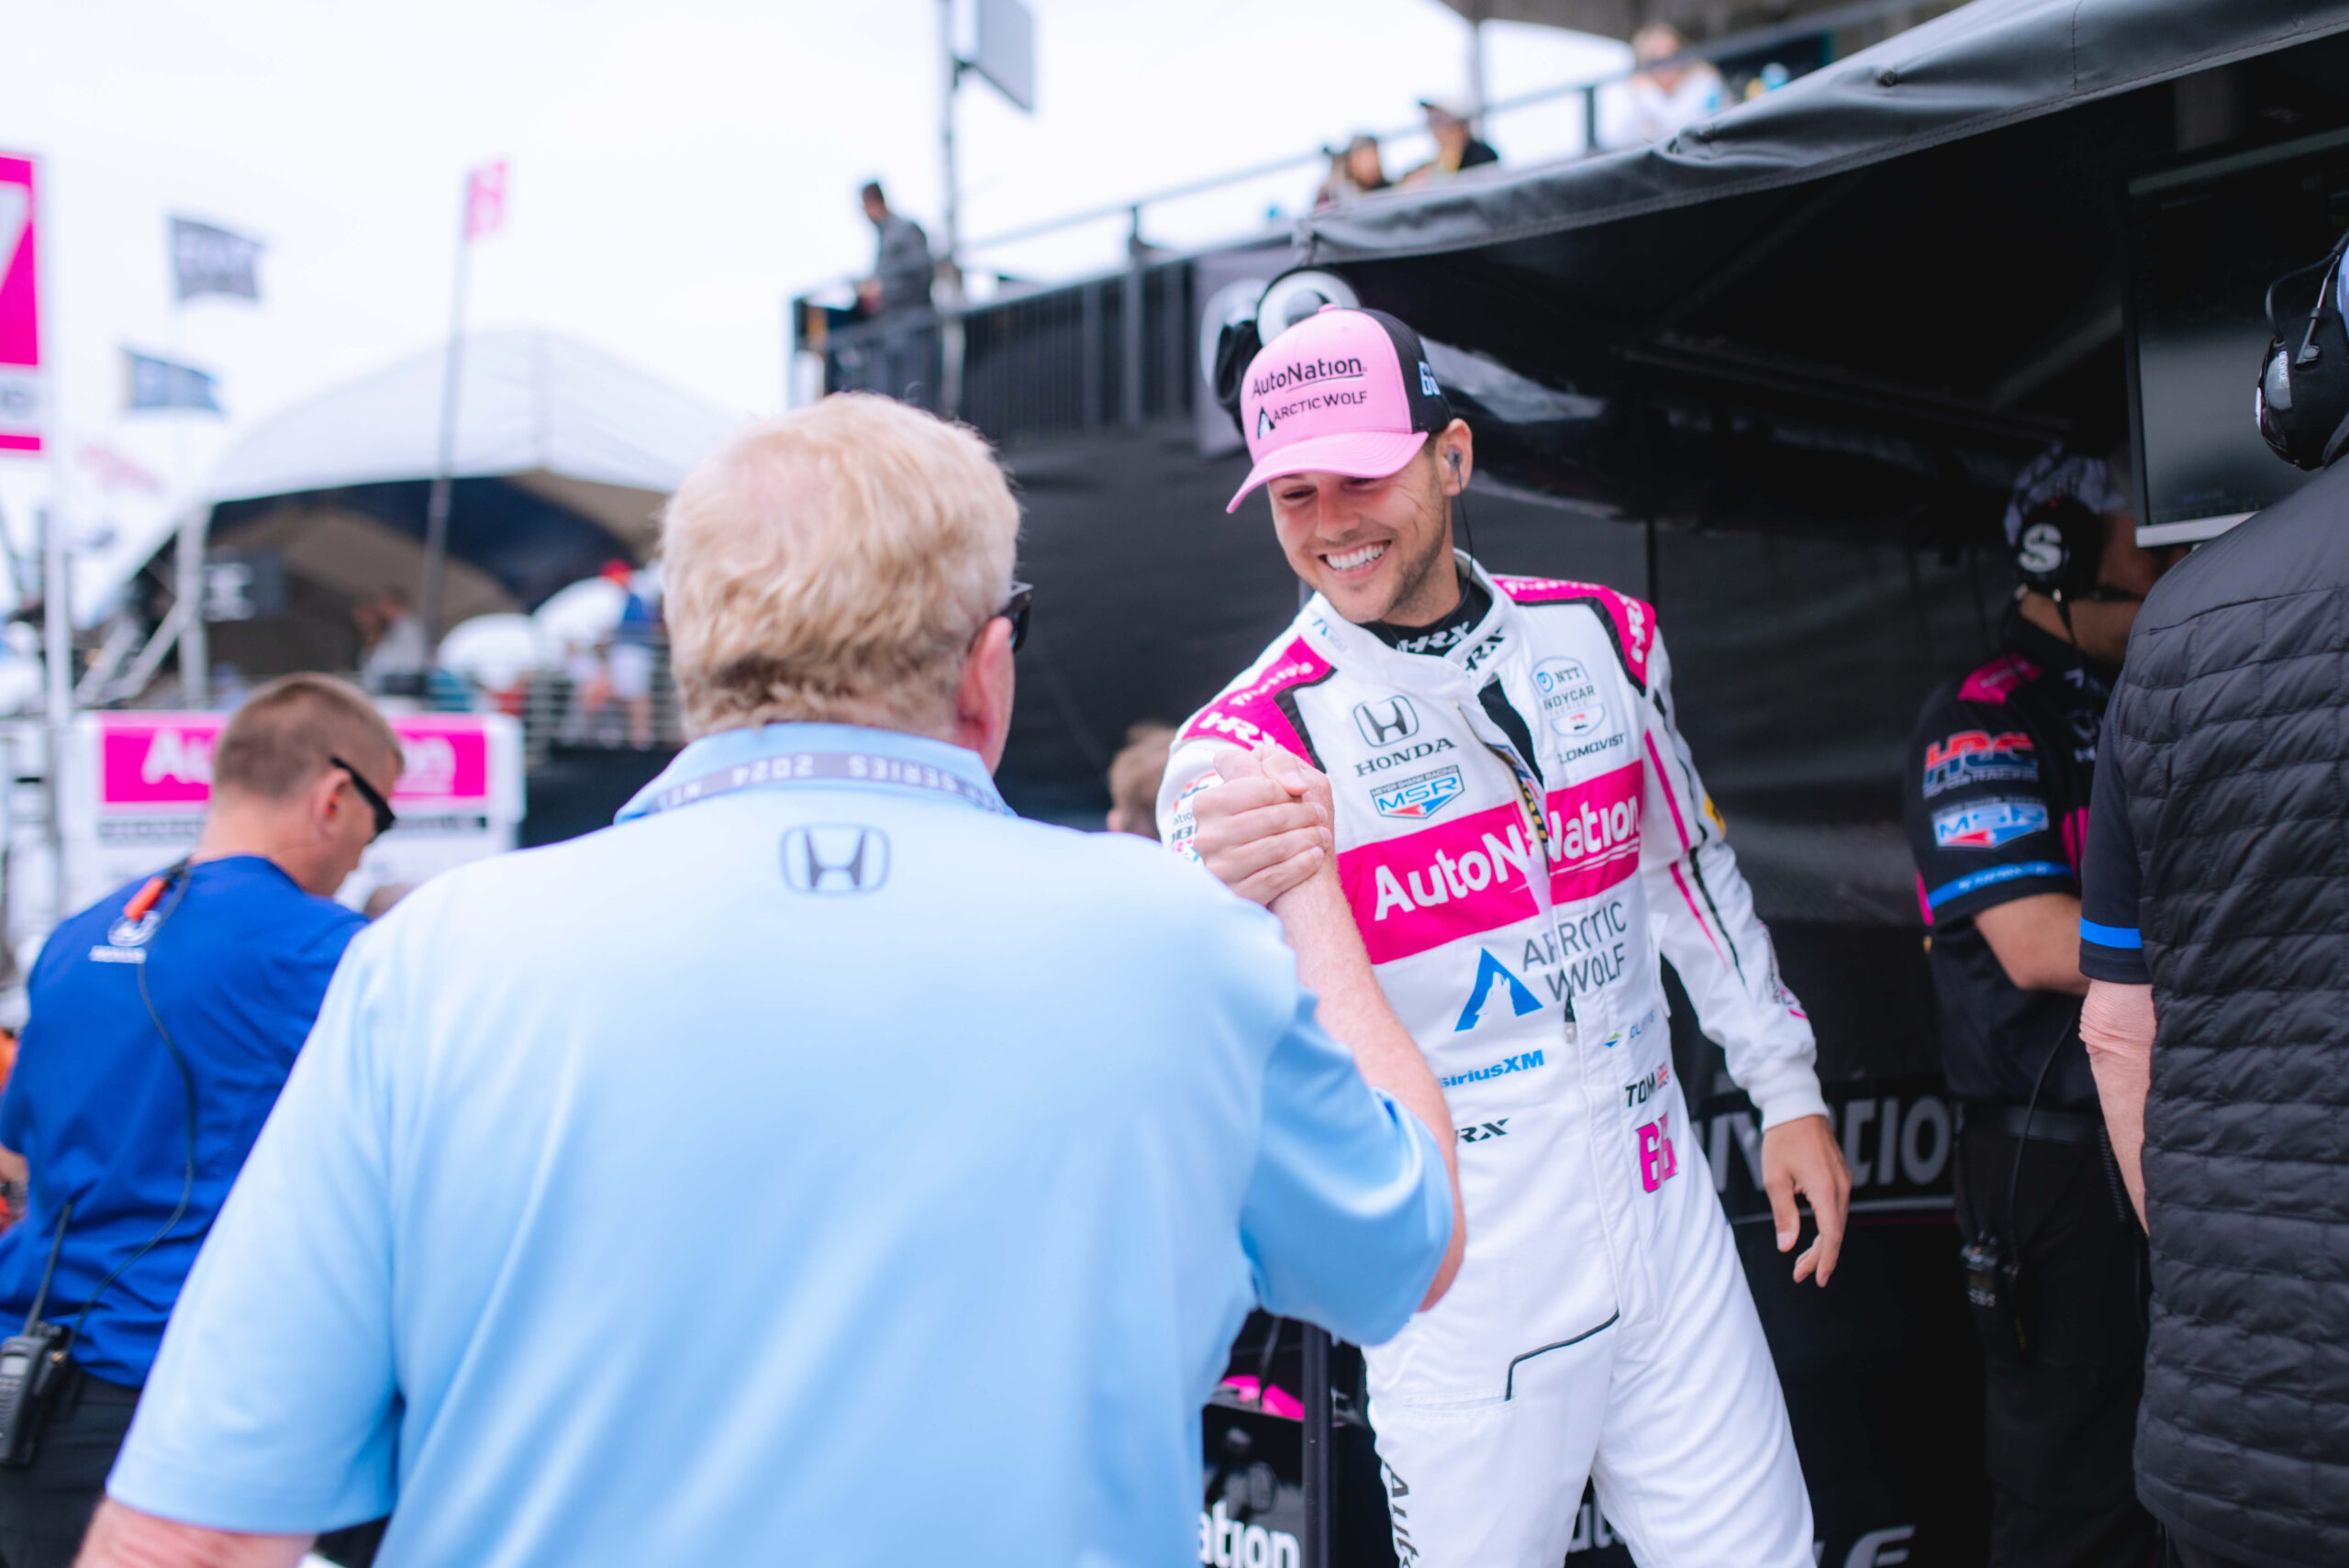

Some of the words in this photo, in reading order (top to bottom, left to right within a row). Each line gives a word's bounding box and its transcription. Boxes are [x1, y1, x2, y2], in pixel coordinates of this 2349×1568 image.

[1252, 357, 1363, 399] AutoNation
[1273, 396, 1322, 423] ARCTIC
[1322, 390, 1367, 407] WOLF
[1554, 666, 1581, 684] NTT
[1353, 737, 1458, 778] HONDA
[1556, 733, 1625, 764] LOMQVIST
[732, 753, 815, 786] 2024
[848, 754, 959, 794] SERIES
[1378, 776, 1458, 811] MSR
[1455, 1118, 1509, 1143] RX
